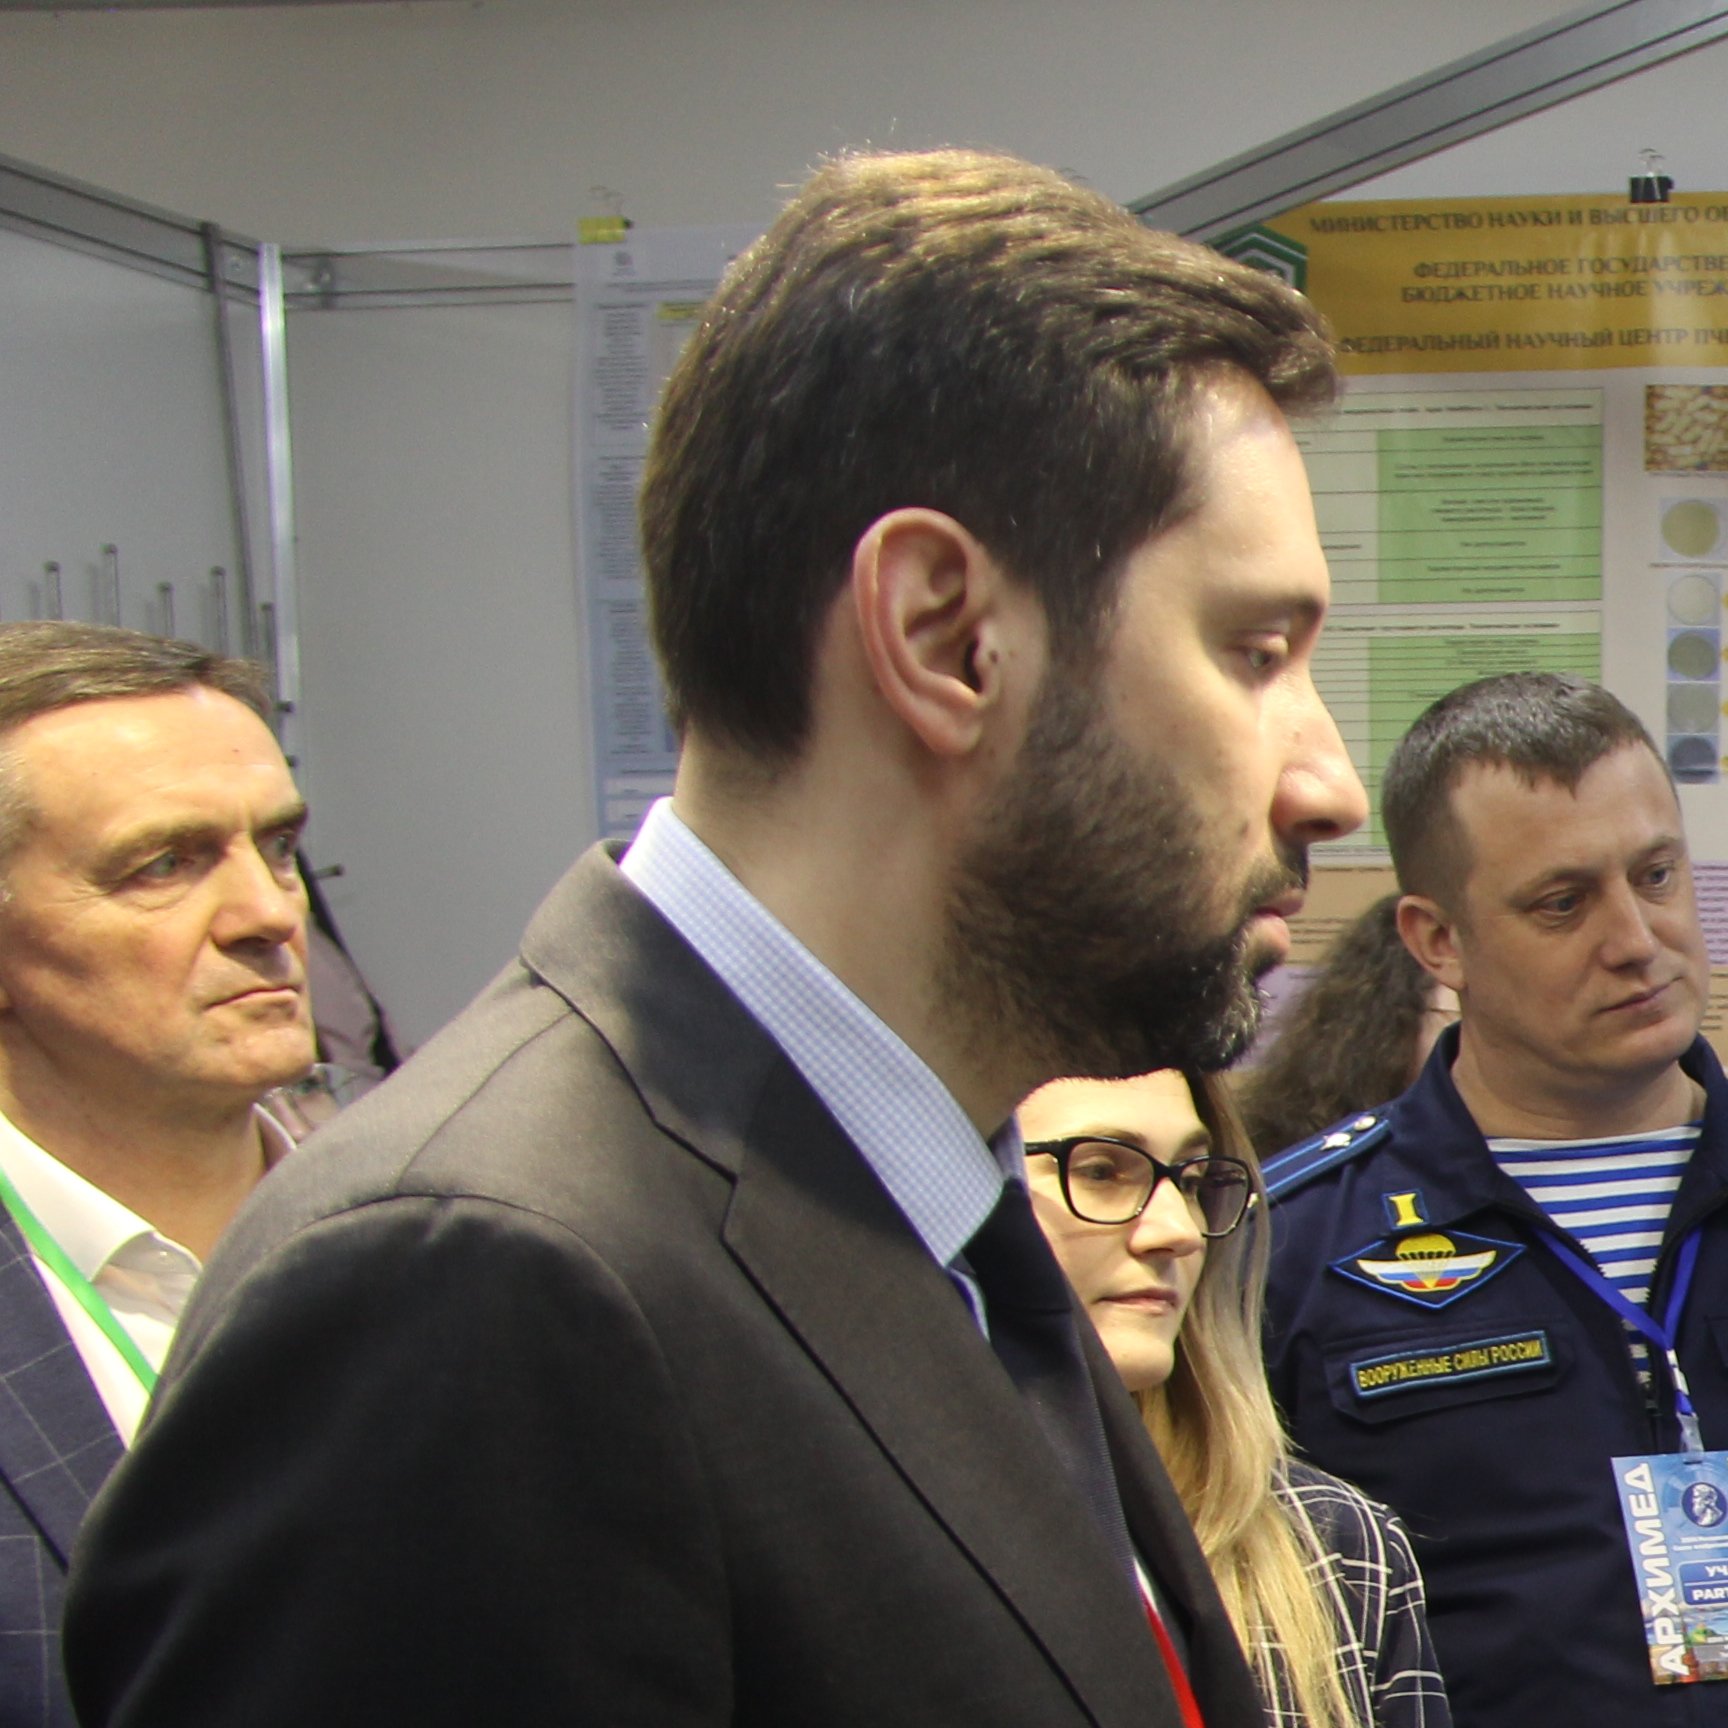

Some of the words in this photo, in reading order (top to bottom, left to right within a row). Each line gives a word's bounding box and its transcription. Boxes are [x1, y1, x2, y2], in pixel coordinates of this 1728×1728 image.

[1488, 210, 1562, 229] НАУКИ
[1567, 210, 1583, 225] И
[1589, 207, 1699, 227] ВЫСШЕГО
[1413, 258, 1571, 279] ФЕДЕРАЛЬНОЕ
[1550, 281, 1647, 300] НАУЧНОЕ
[1506, 328, 1614, 350] НАУЧНЫЙ
[1619, 329, 1689, 348] ЦЕНТР
[1357, 1356, 1452, 1388] ВООРУЖЕННЫЕ
[1453, 1349, 1490, 1371] СИЛЫ
[1491, 1339, 1544, 1363] РОССИИ
[1622, 1462, 1691, 1677] АРХИМЕД
